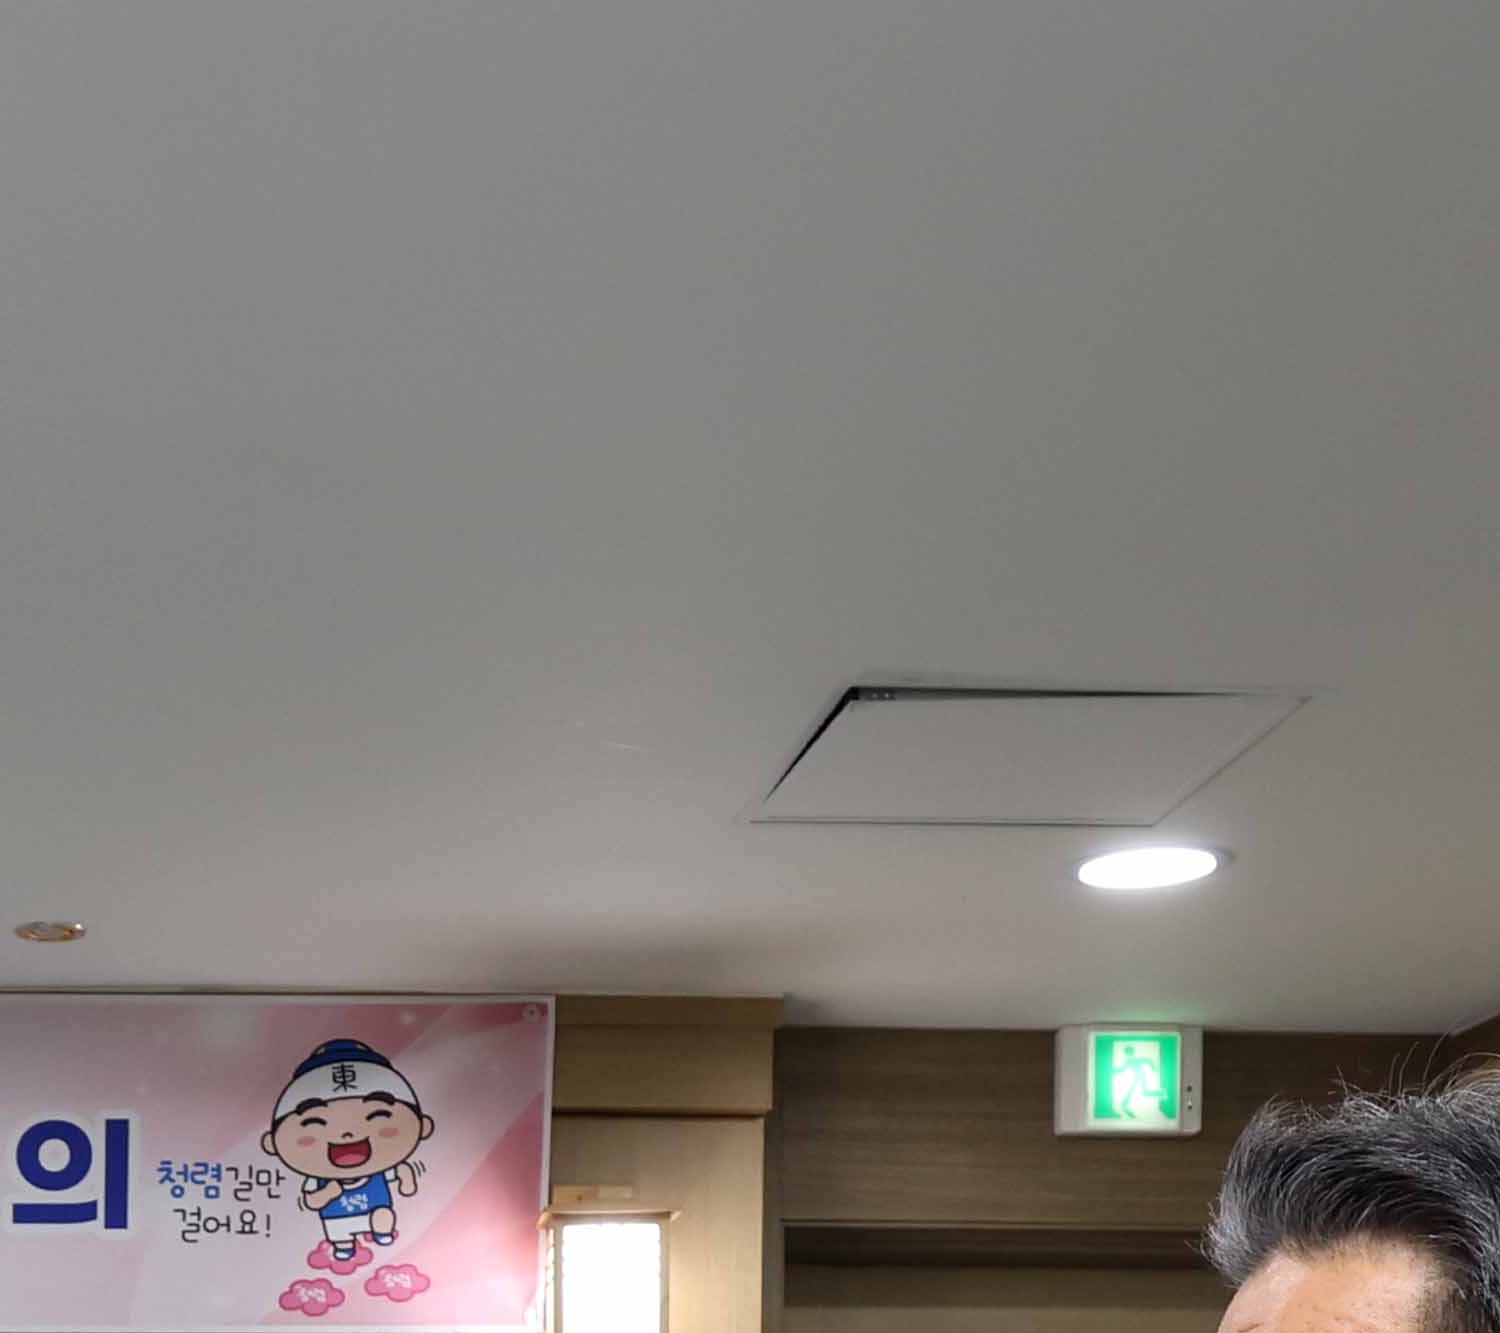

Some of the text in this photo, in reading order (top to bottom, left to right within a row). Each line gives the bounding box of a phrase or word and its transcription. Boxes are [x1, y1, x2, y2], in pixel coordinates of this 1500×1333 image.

[331, 1063, 357, 1092] 東
[157, 1160, 287, 1202] 청렴길만
[172, 1206, 272, 1244] 걸어요!
